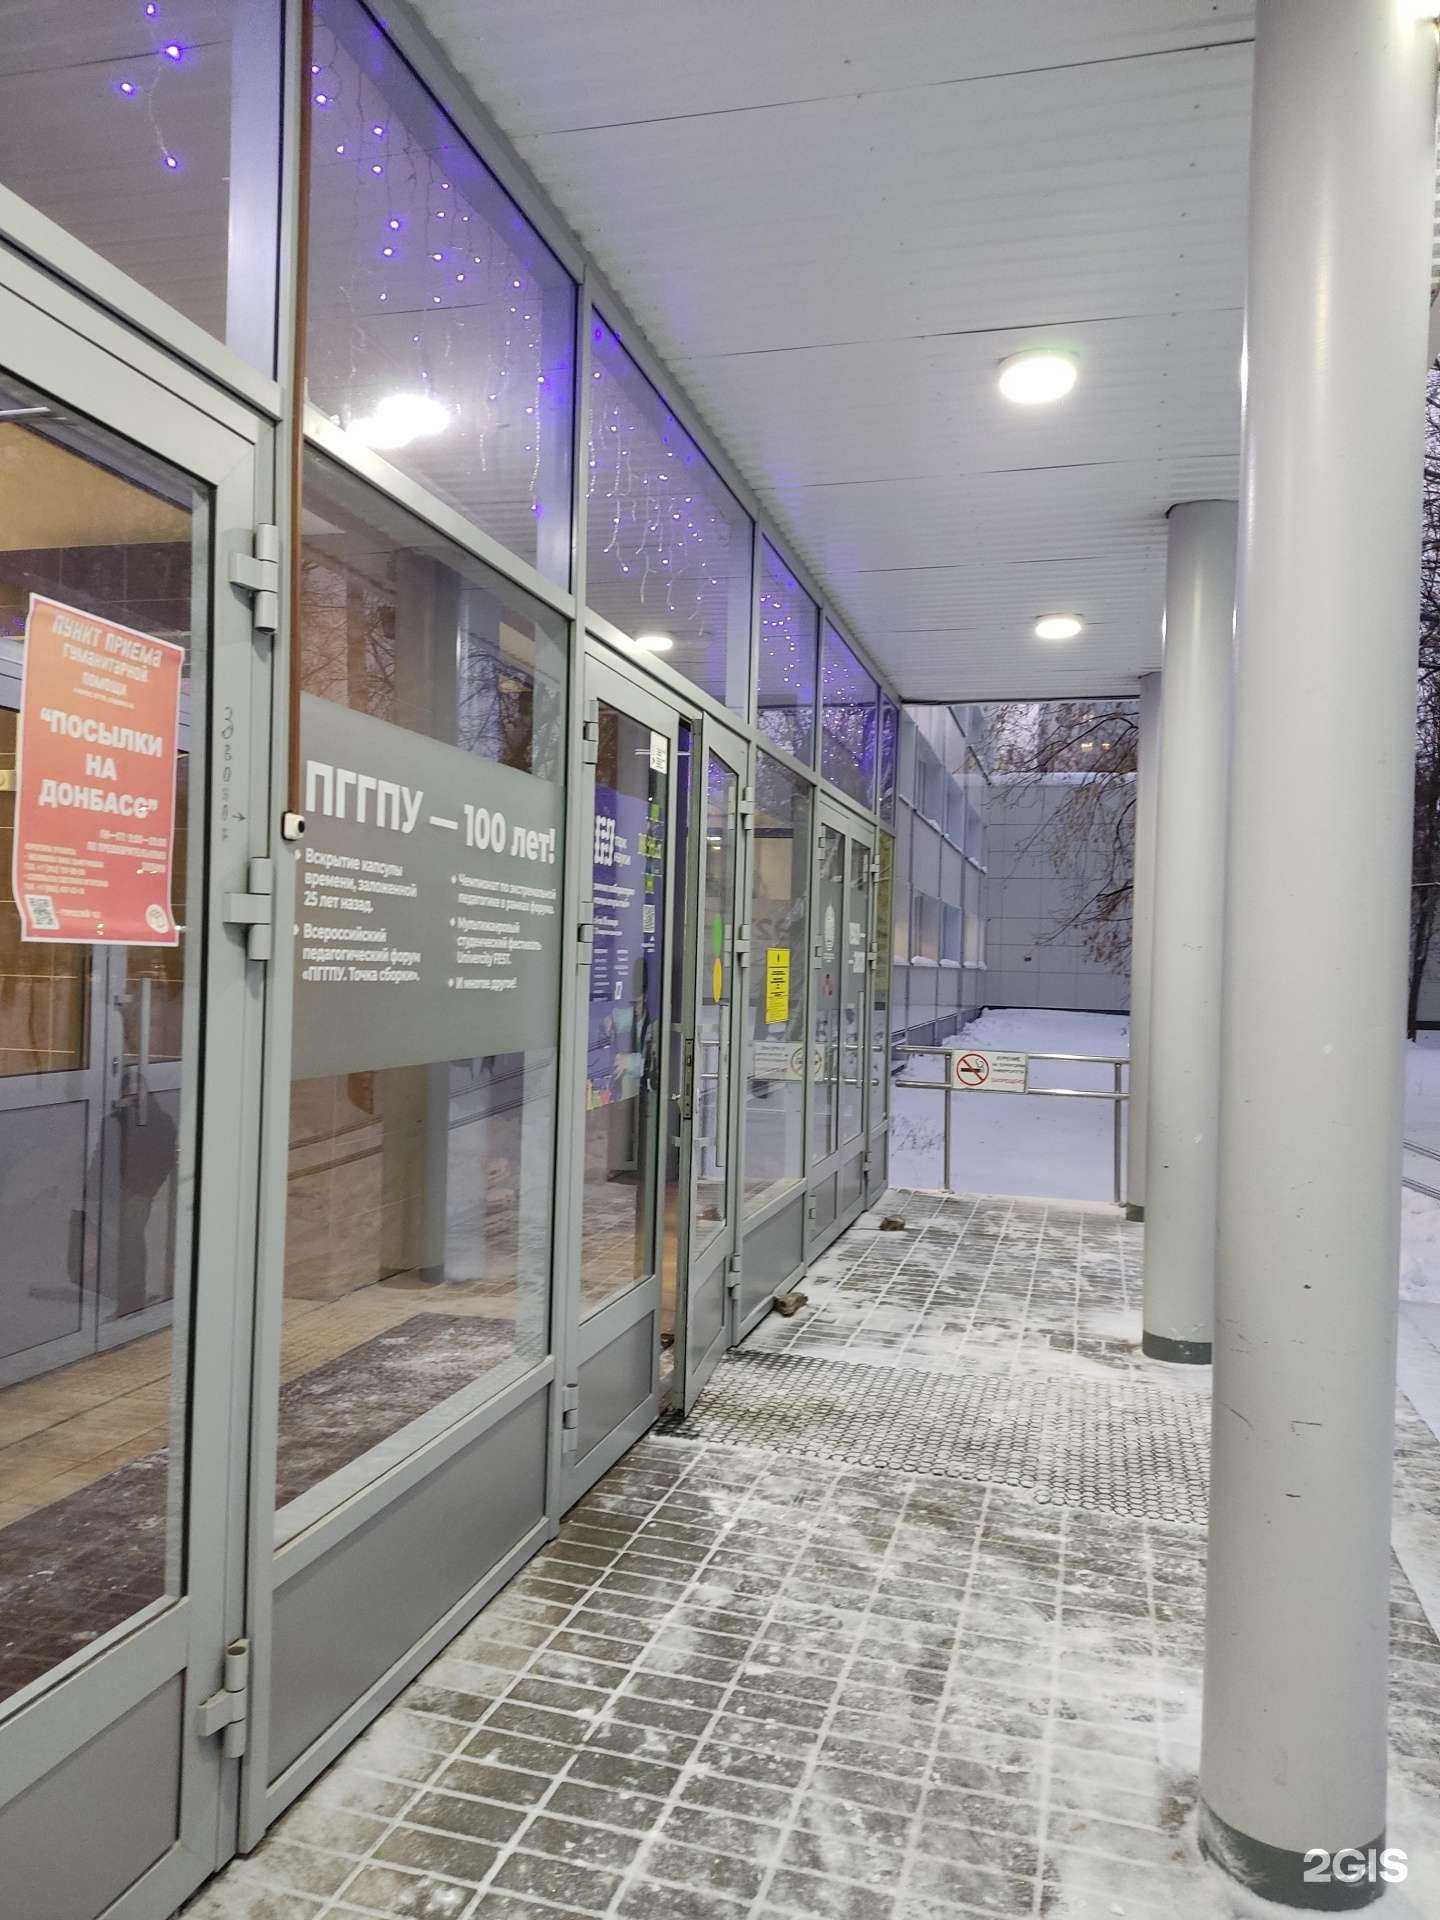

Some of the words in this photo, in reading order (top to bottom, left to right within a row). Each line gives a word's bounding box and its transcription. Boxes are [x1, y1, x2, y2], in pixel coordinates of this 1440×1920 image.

[85, 752, 118, 781] НА
[305, 759, 424, 834] ПГГПУ
[463, 803, 506, 853] 100
[510, 825, 556, 864] лет!
[305, 847, 361, 869] Вскрытие
[303, 890, 318, 907] 25
[318, 895, 340, 909] лет
[303, 922, 387, 943] Всероссийский
[302, 947, 390, 963] педагогический
[347, 966, 378, 982] Точка
